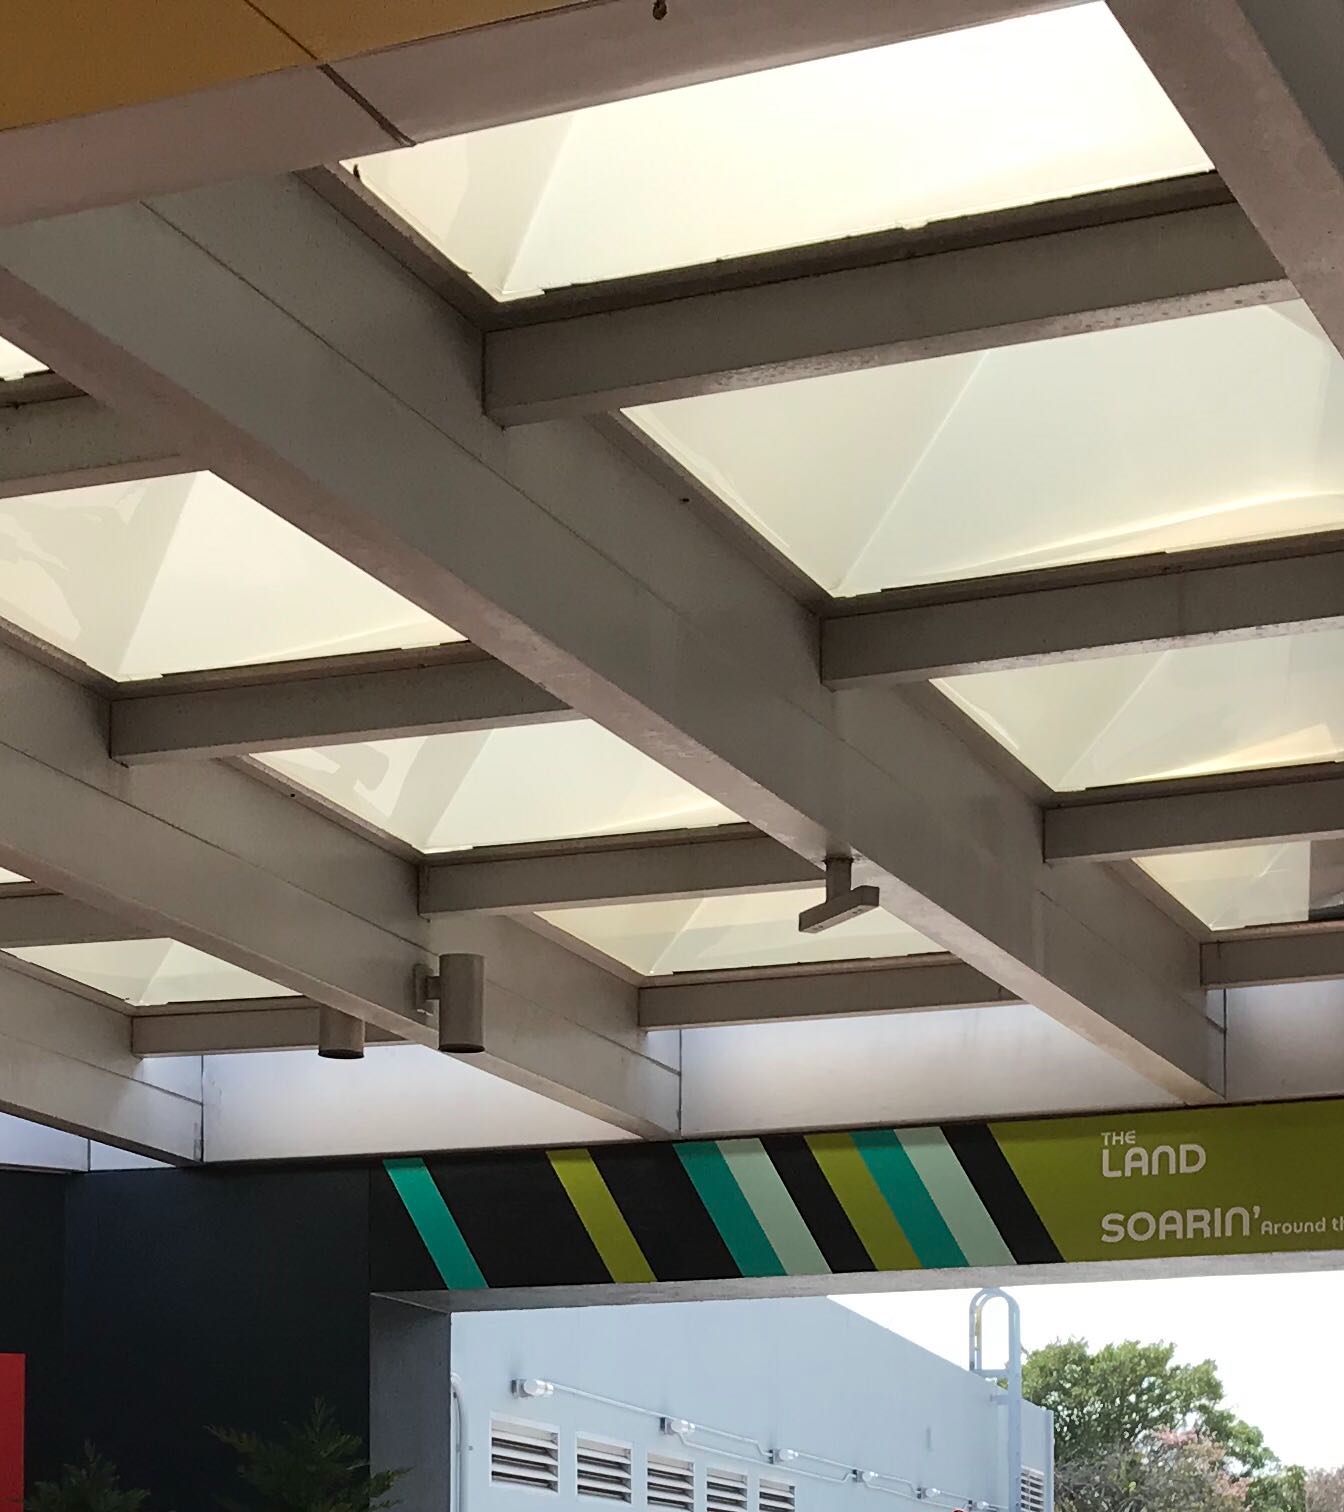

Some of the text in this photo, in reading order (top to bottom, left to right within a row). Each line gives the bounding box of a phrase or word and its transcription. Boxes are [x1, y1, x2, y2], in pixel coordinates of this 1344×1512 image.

[1101, 1130, 1136, 1146] THE
[1102, 1144, 1206, 1177] LAND
[1101, 1205, 1261, 1243] SOARIN'
[1261, 1217, 1326, 1235] Around
